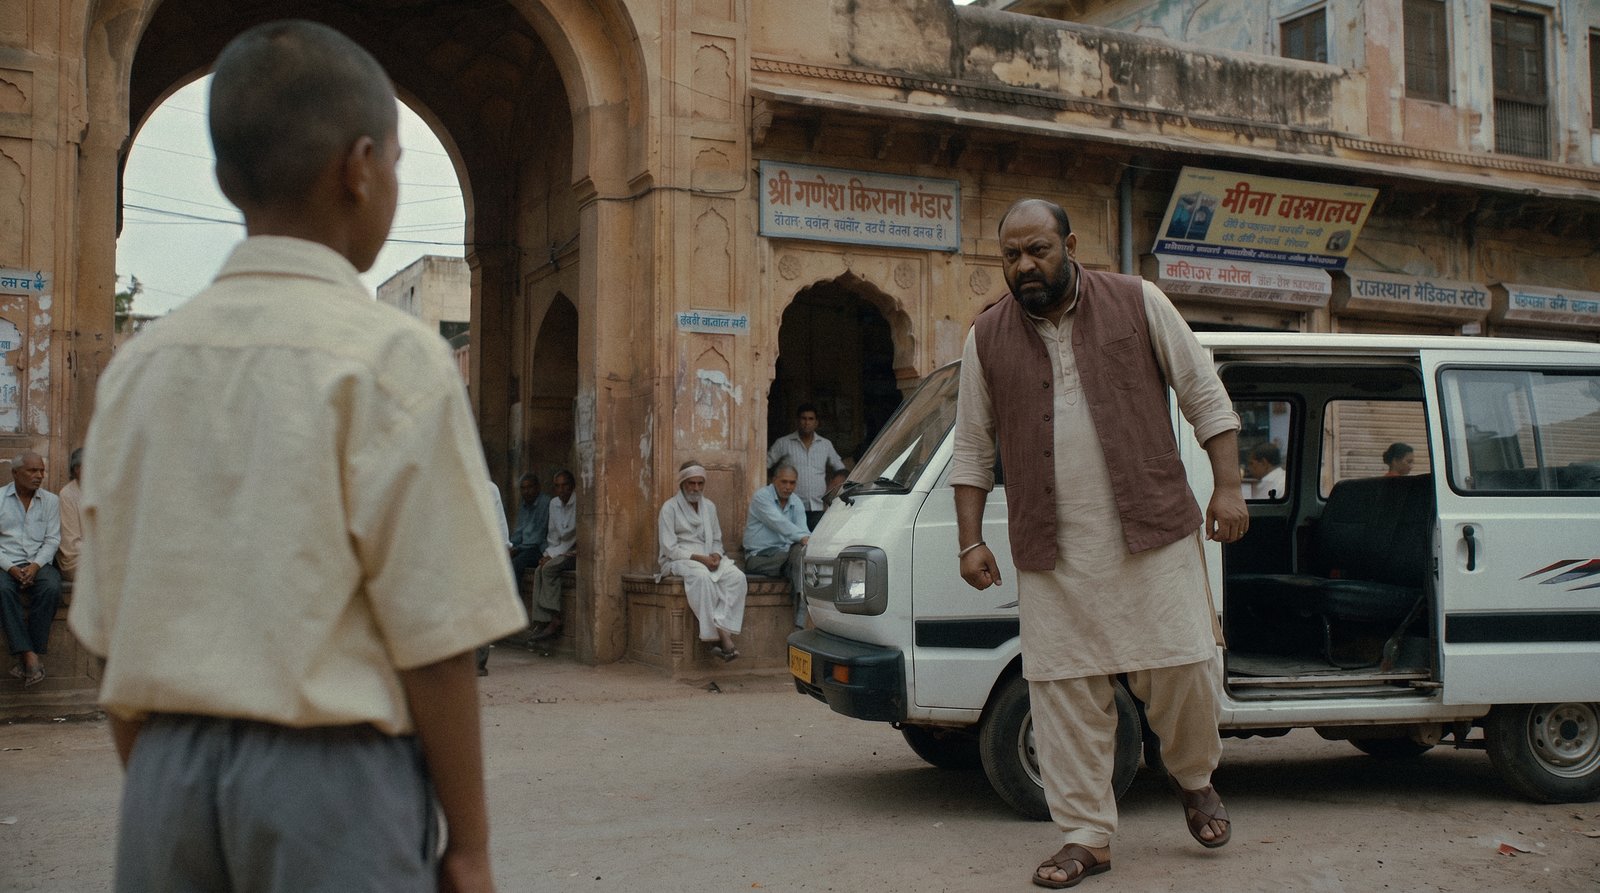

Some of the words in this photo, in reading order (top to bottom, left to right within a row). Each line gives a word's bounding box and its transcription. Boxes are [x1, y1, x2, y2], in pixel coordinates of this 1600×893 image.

[768, 170, 792, 206] श्री
[795, 175, 845, 211] गणेश
[848, 177, 906, 216] किराना
[910, 184, 954, 220] भंडार
[1222, 181, 1277, 216] मीना
[1278, 195, 1367, 225] वस्त्रालय
[1357, 279, 1411, 300] राजस्थान
[1414, 281, 1457, 305] मेडिकल
[1460, 287, 1487, 307] स्टोर
